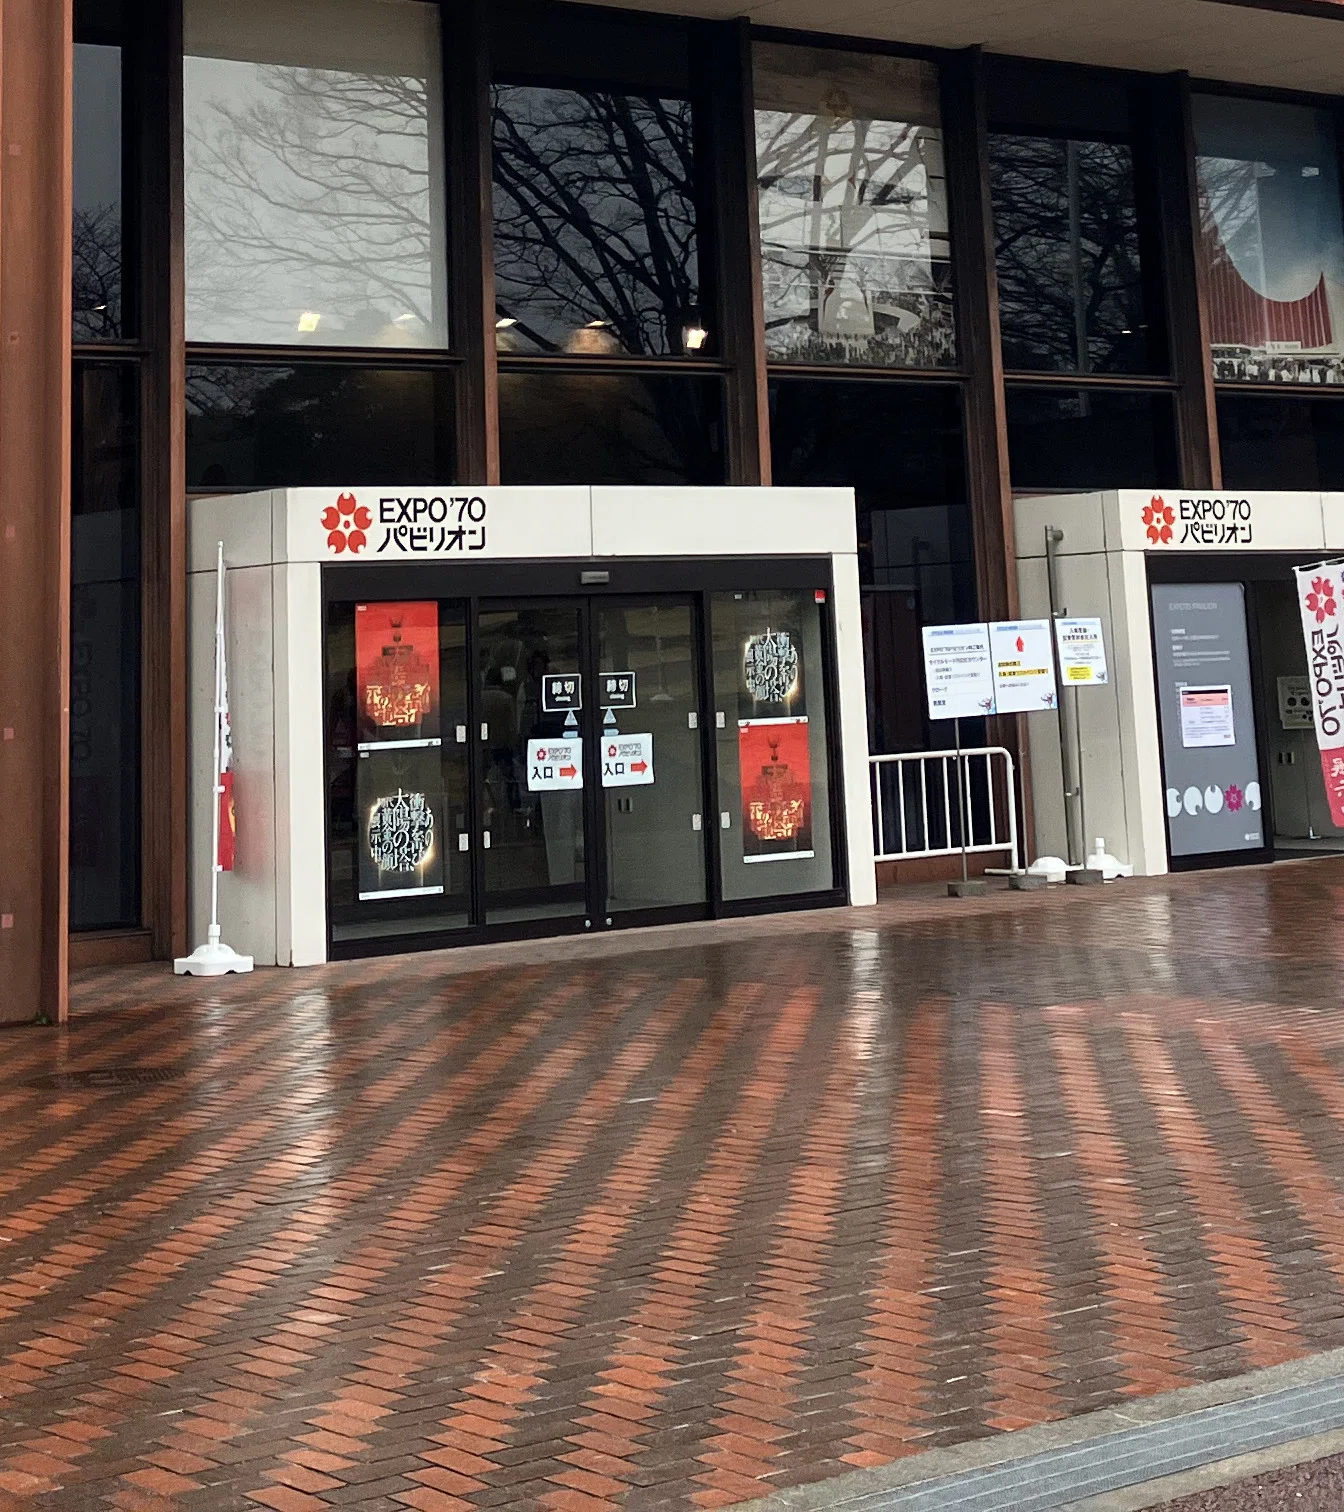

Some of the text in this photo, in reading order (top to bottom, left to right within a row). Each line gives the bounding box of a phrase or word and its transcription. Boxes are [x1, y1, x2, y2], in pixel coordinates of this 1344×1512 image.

[379, 496, 487, 523] EXPO'70
[1179, 499, 1251, 521] EXPO'70
[376, 524, 486, 553] パビリオン
[1179, 522, 1252, 544] パビリオン
[532, 766, 554, 780] 入口
[603, 762, 625, 776] 入口
